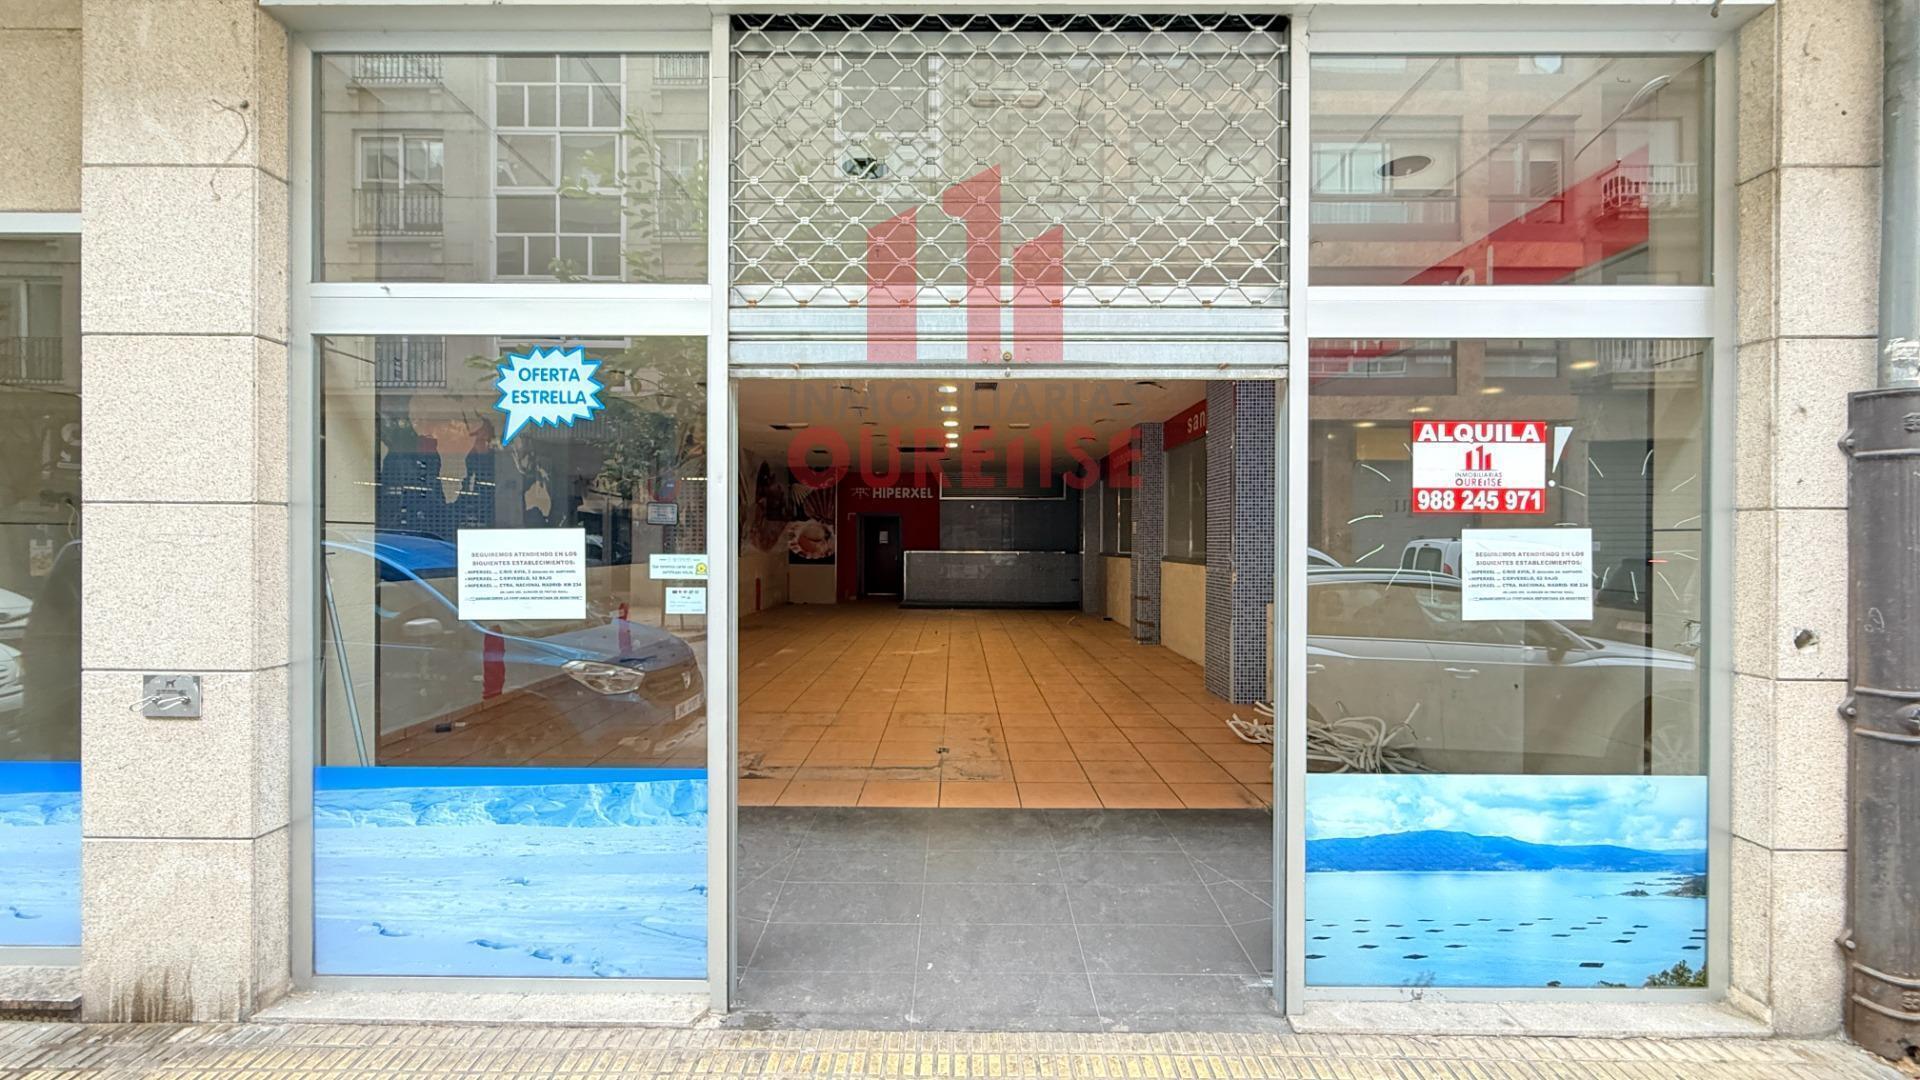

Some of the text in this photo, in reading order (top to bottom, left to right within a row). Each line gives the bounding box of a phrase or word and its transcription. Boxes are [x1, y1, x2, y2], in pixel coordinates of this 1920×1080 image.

[518, 367, 581, 382] OFERTA
[511, 390, 587, 404] ESTRELLA
[1417, 423, 1541, 444] ALQUILA
[872, 487, 934, 499] HIPERXEL
[1417, 489, 1456, 511] 988
[1461, 489, 1500, 511] 245
[1505, 489, 1541, 511] 971
